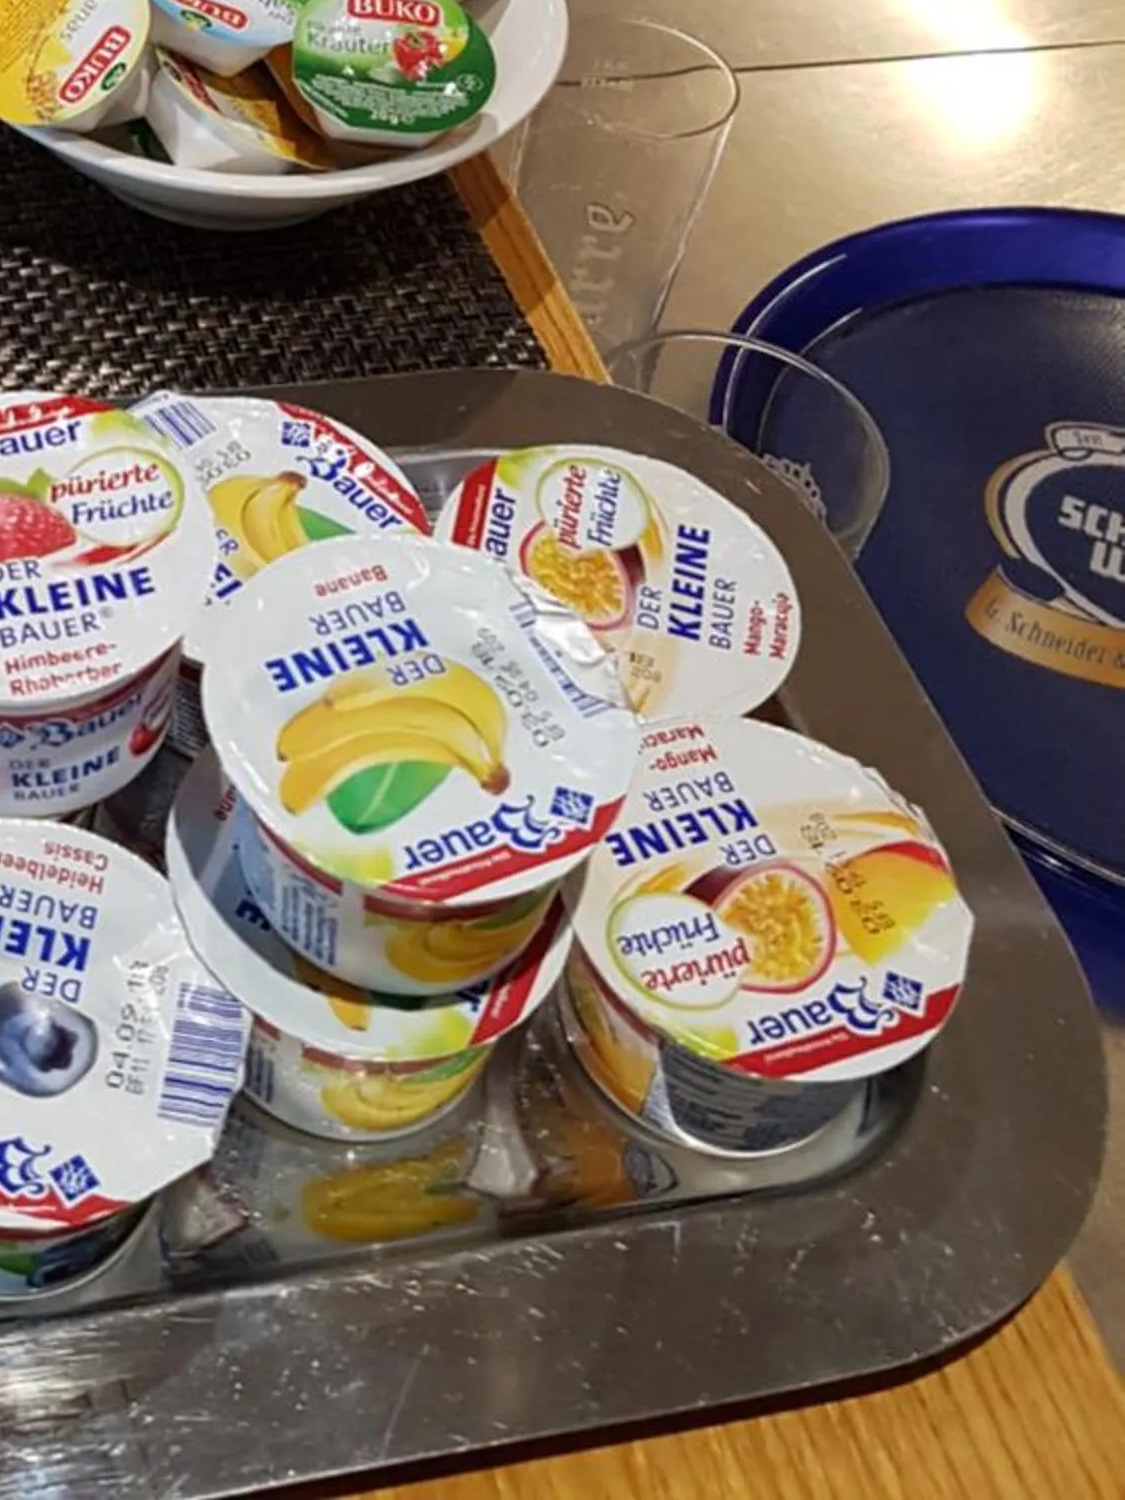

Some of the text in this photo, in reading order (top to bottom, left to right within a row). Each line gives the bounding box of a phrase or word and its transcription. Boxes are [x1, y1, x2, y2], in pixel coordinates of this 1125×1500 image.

[64, 29, 127, 100] BUKO
[51, 462, 160, 503] pürierte
[71, 489, 174, 525] Früchte
[557, 464, 588, 549] pürierte
[487, 488, 517, 562] auer
[587, 468, 623, 548] Früchte
[315, 565, 388, 598] Banane
[668, 523, 710, 641] KLEINE
[314, 590, 406, 638] BAUER
[636, 586, 663, 631] DER
[708, 577, 739, 650] BAUER
[263, 619, 428, 694] KLEINE
[1005, 611, 1105, 666] Schneider
[390, 652, 447, 688] DER
[12, 747, 121, 788] KLEINE
[644, 770, 735, 812] BAUER
[44, 841, 110, 871] Cassis
[405, 794, 560, 872] Bauer
[604, 798, 759, 867] KLEINE
[724, 833, 777, 867] DER
[617, 912, 721, 957] Früchte
[20, 967, 83, 1003] DER
[640, 940, 751, 992] pürierte
[748, 975, 895, 1046] Bauer
